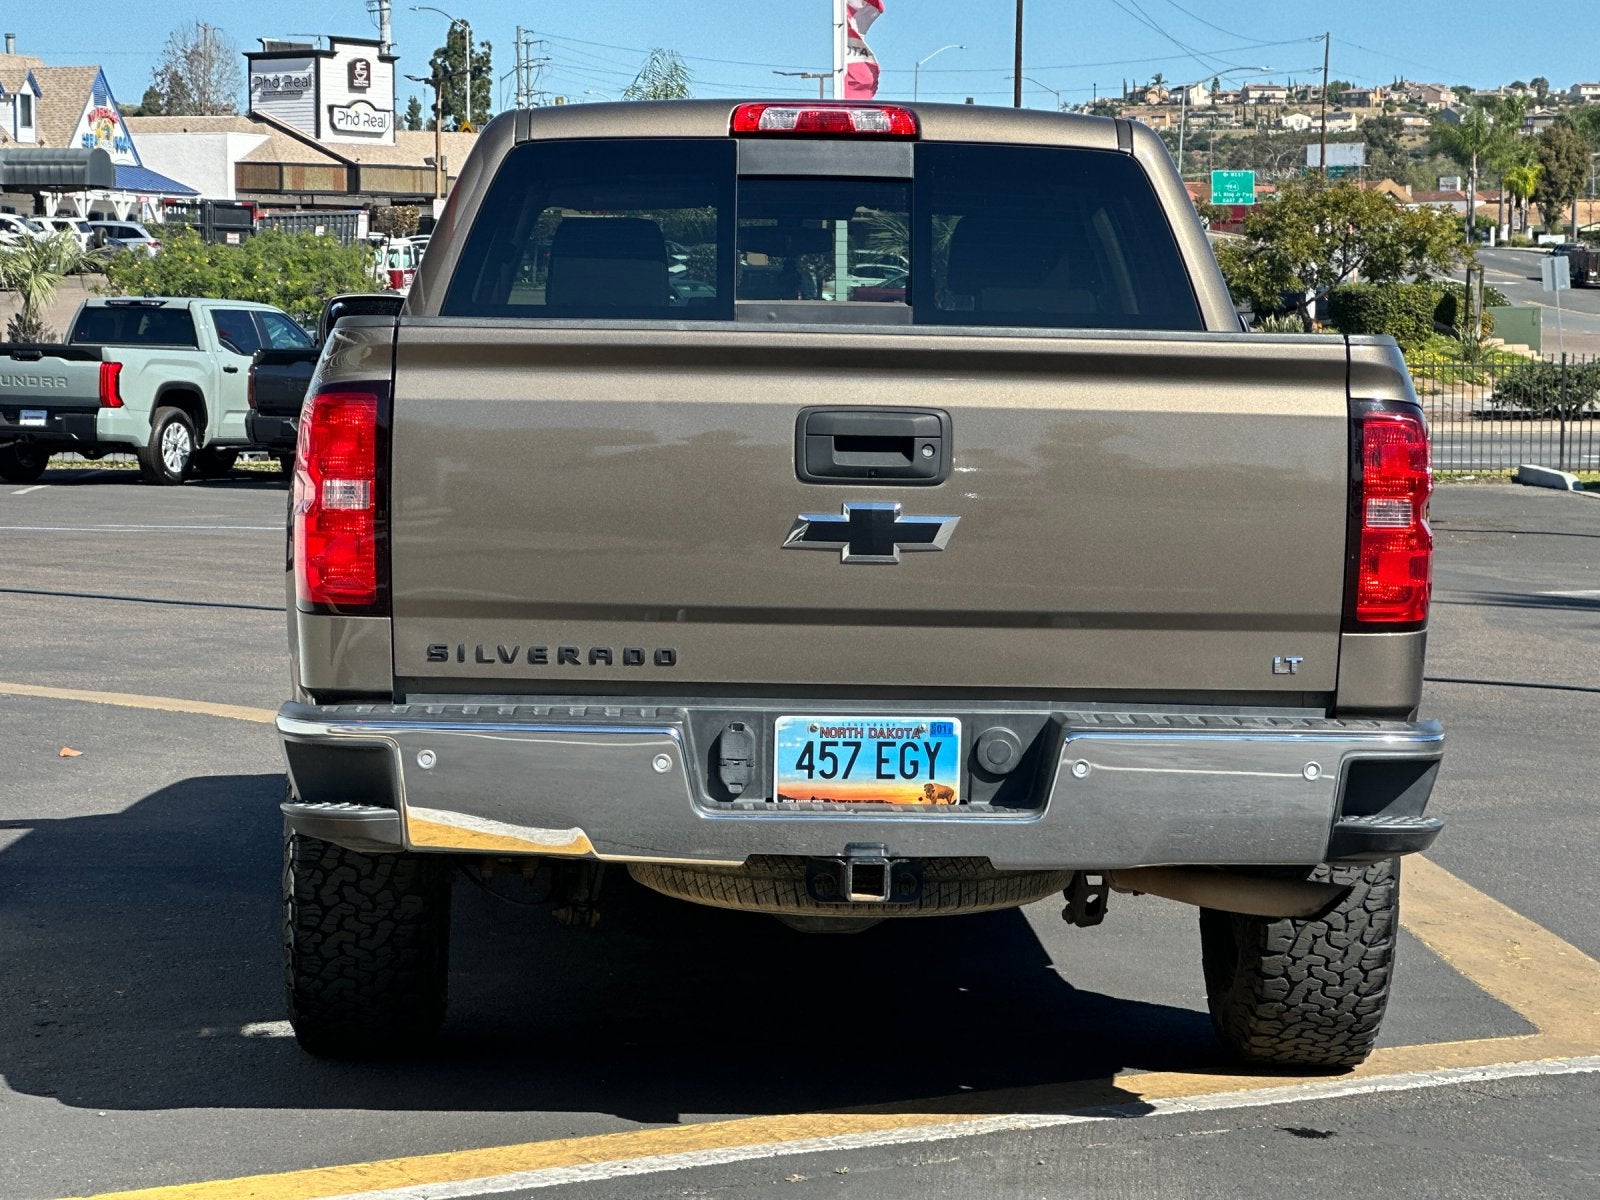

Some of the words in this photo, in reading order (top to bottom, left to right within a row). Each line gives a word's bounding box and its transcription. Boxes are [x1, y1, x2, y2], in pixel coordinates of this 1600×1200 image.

[284, 73, 312, 88] Real
[363, 112, 386, 129] Real
[426, 643, 677, 667] SILVERADO
[1272, 656, 1303, 675] LT
[819, 727, 864, 739] NORTH
[868, 728, 922, 739] DAKOTA
[795, 741, 862, 780] 457
[875, 741, 943, 780] EGY
